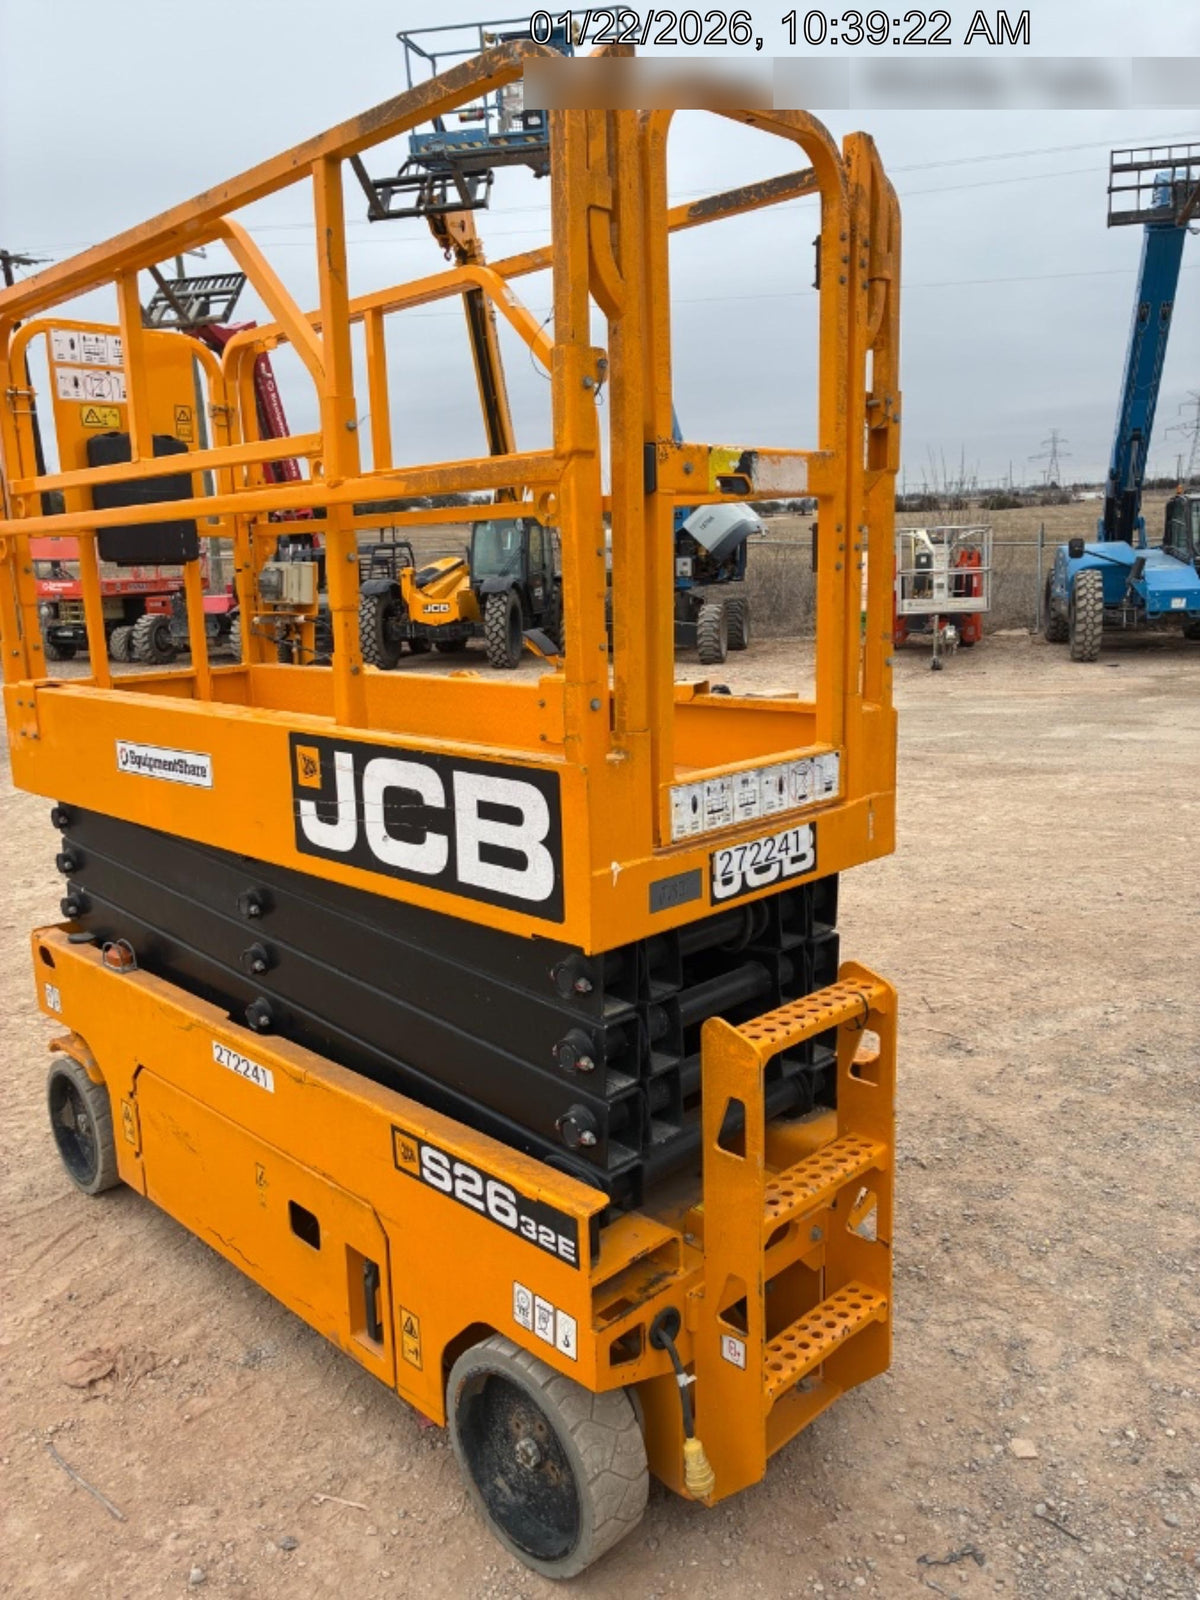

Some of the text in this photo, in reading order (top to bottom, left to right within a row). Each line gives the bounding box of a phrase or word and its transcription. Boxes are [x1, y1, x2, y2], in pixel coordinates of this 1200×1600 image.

[423, 603, 450, 613] JCB
[129, 749, 208, 778] EquipmentShare
[300, 751, 555, 902] JCB
[719, 830, 801, 878] 272241
[214, 1044, 268, 1088] 272241
